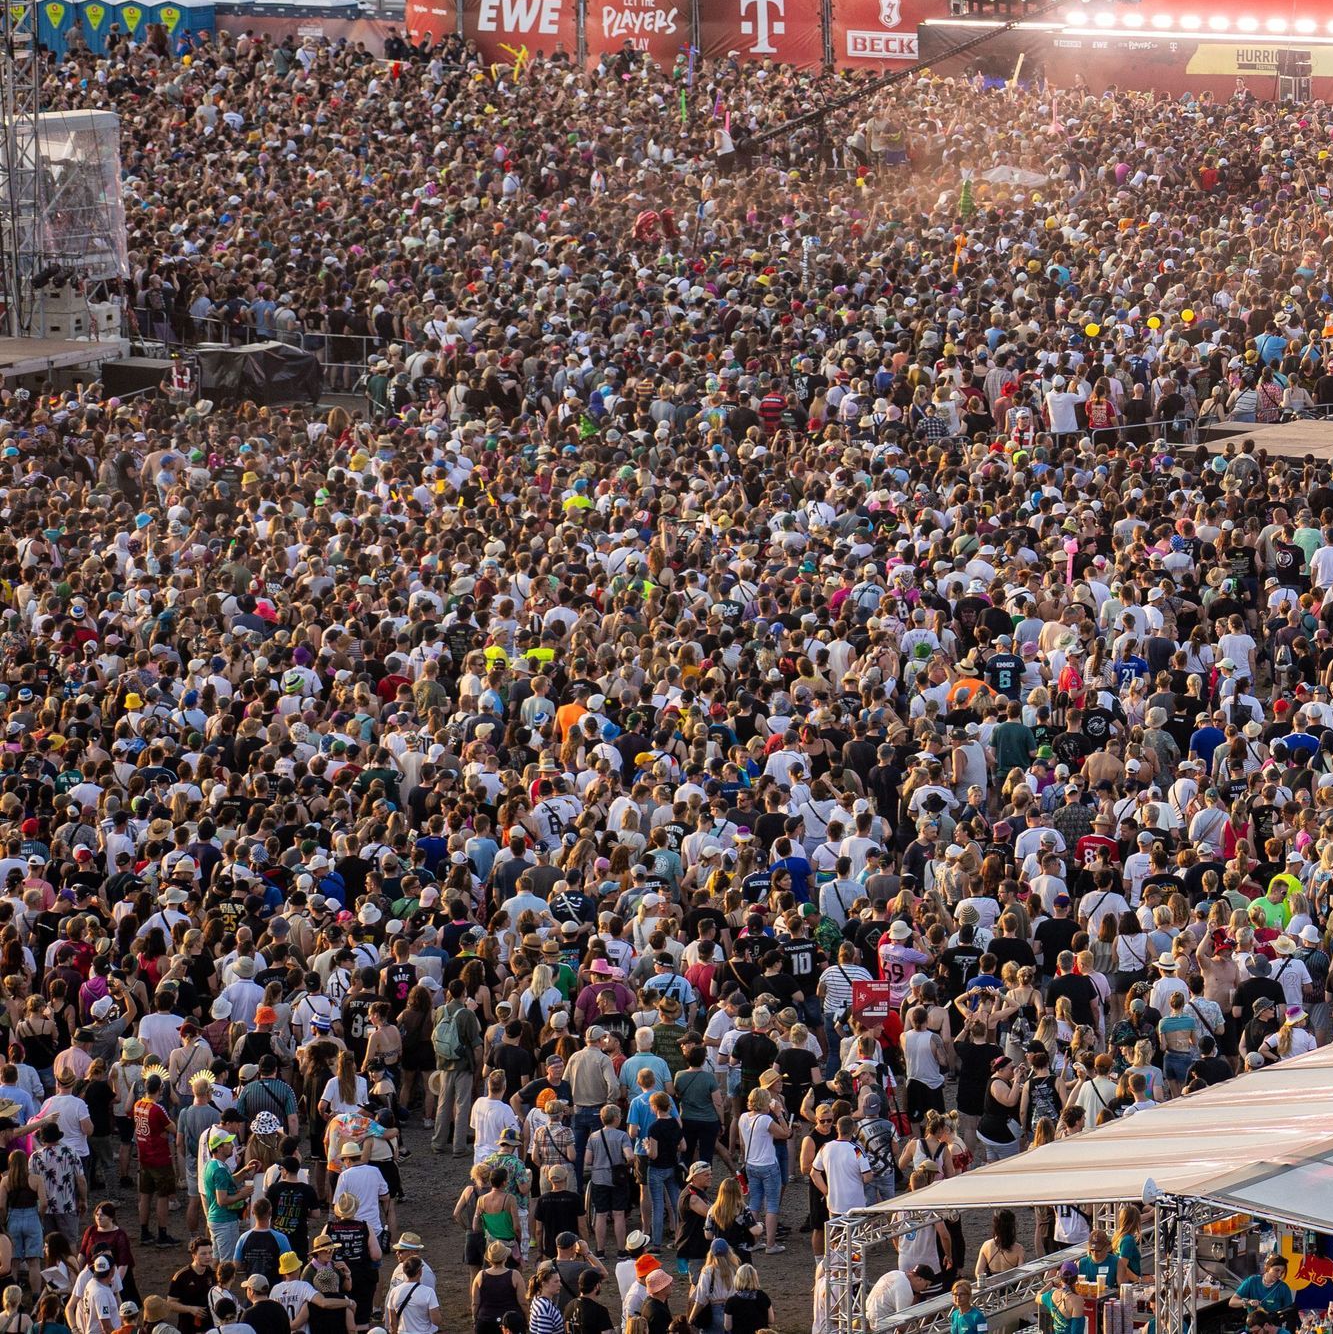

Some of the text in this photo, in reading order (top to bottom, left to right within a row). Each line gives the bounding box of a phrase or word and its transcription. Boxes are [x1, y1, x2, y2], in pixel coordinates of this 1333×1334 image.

[602, 5, 679, 38] PLAYERS
[852, 34, 916, 55] BECK
[999, 669, 1011, 689] 6
[791, 952, 813, 976] 10
[393, 973, 409, 982] WADE
[395, 982, 409, 1000] 3
[134, 1116, 150, 1136] 25
